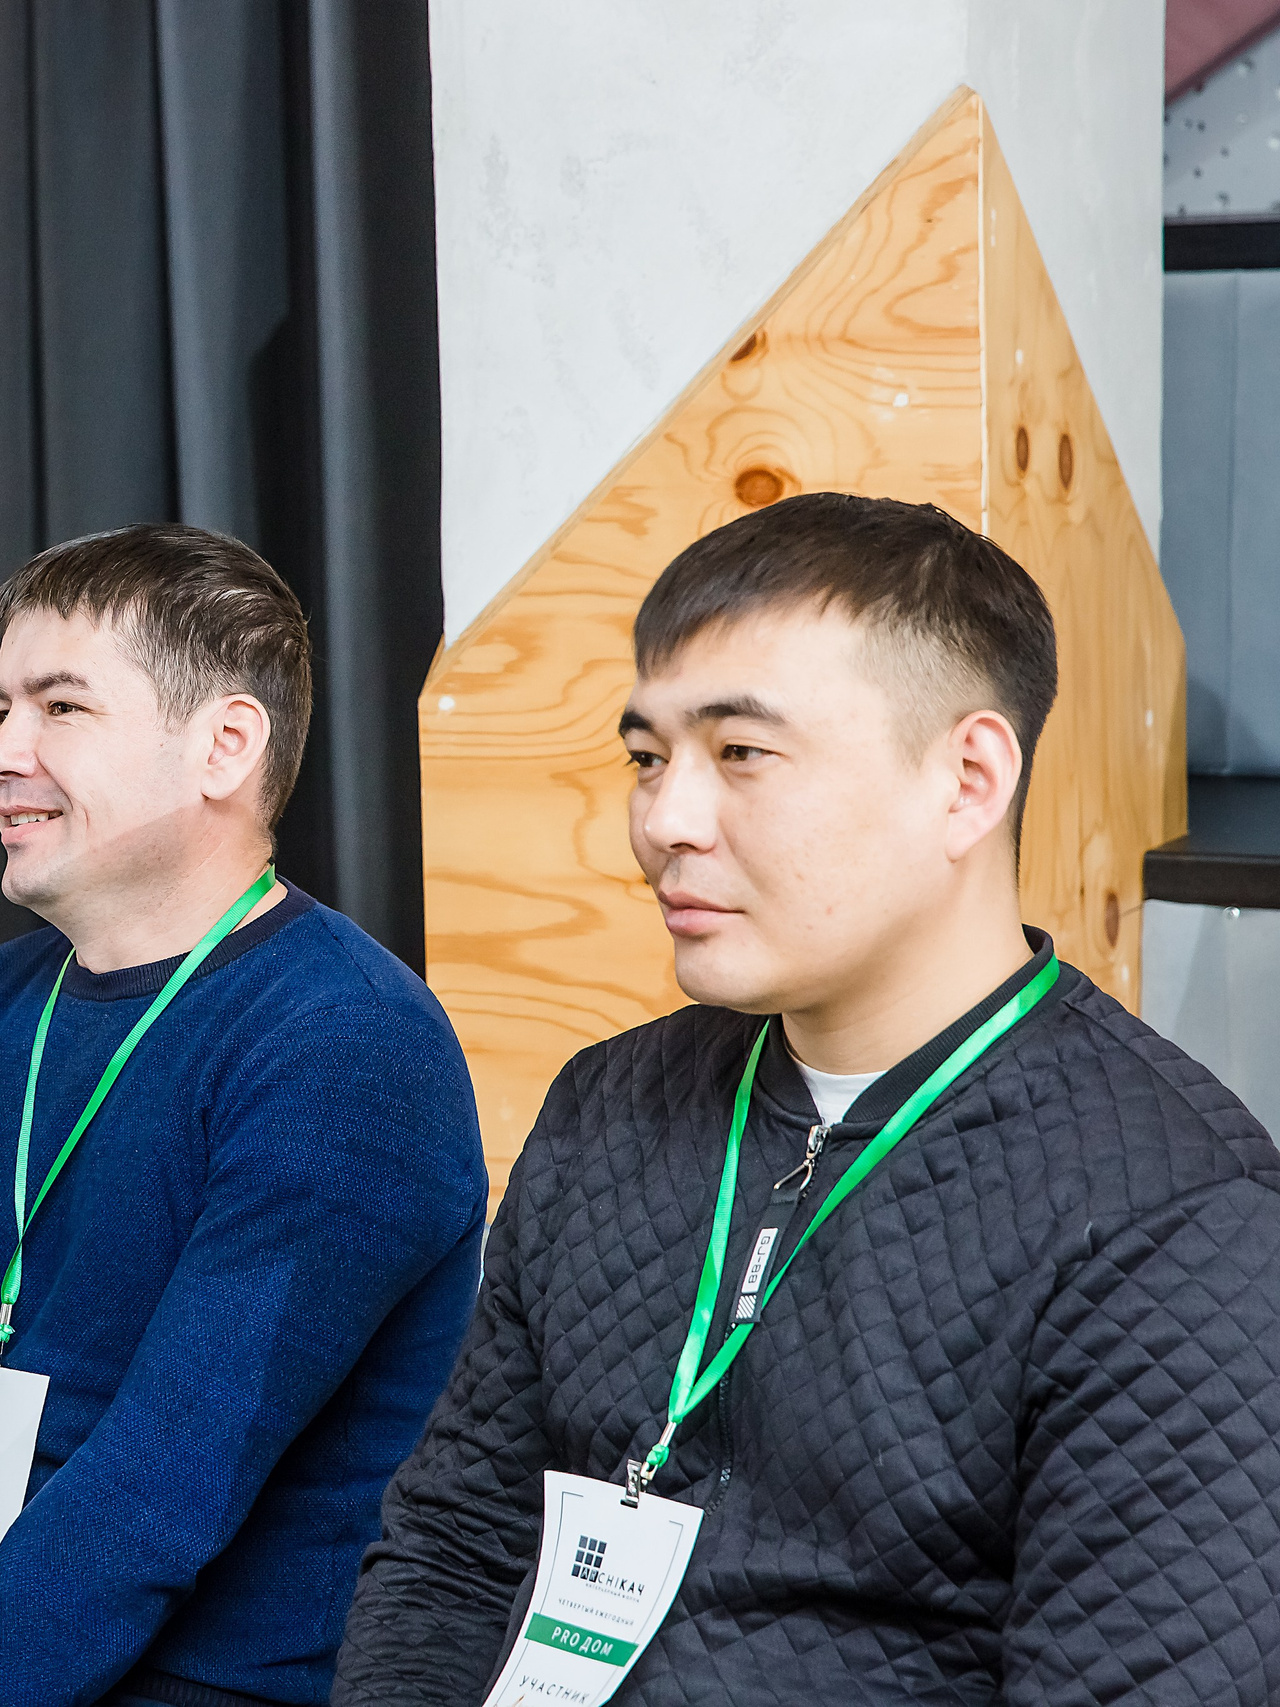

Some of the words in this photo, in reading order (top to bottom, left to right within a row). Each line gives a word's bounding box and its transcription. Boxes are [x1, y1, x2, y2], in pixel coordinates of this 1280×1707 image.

[748, 1236, 770, 1283] GJ-88
[558, 1597, 594, 1614] ЧЕТВЕРТЫЙ
[594, 1609, 635, 1626] ЕЖЕГОДНЫЙ
[551, 1626, 580, 1647] PRO
[578, 1636, 614, 1656] ДОМ
[519, 1675, 591, 1704] УЧАСТНИК
